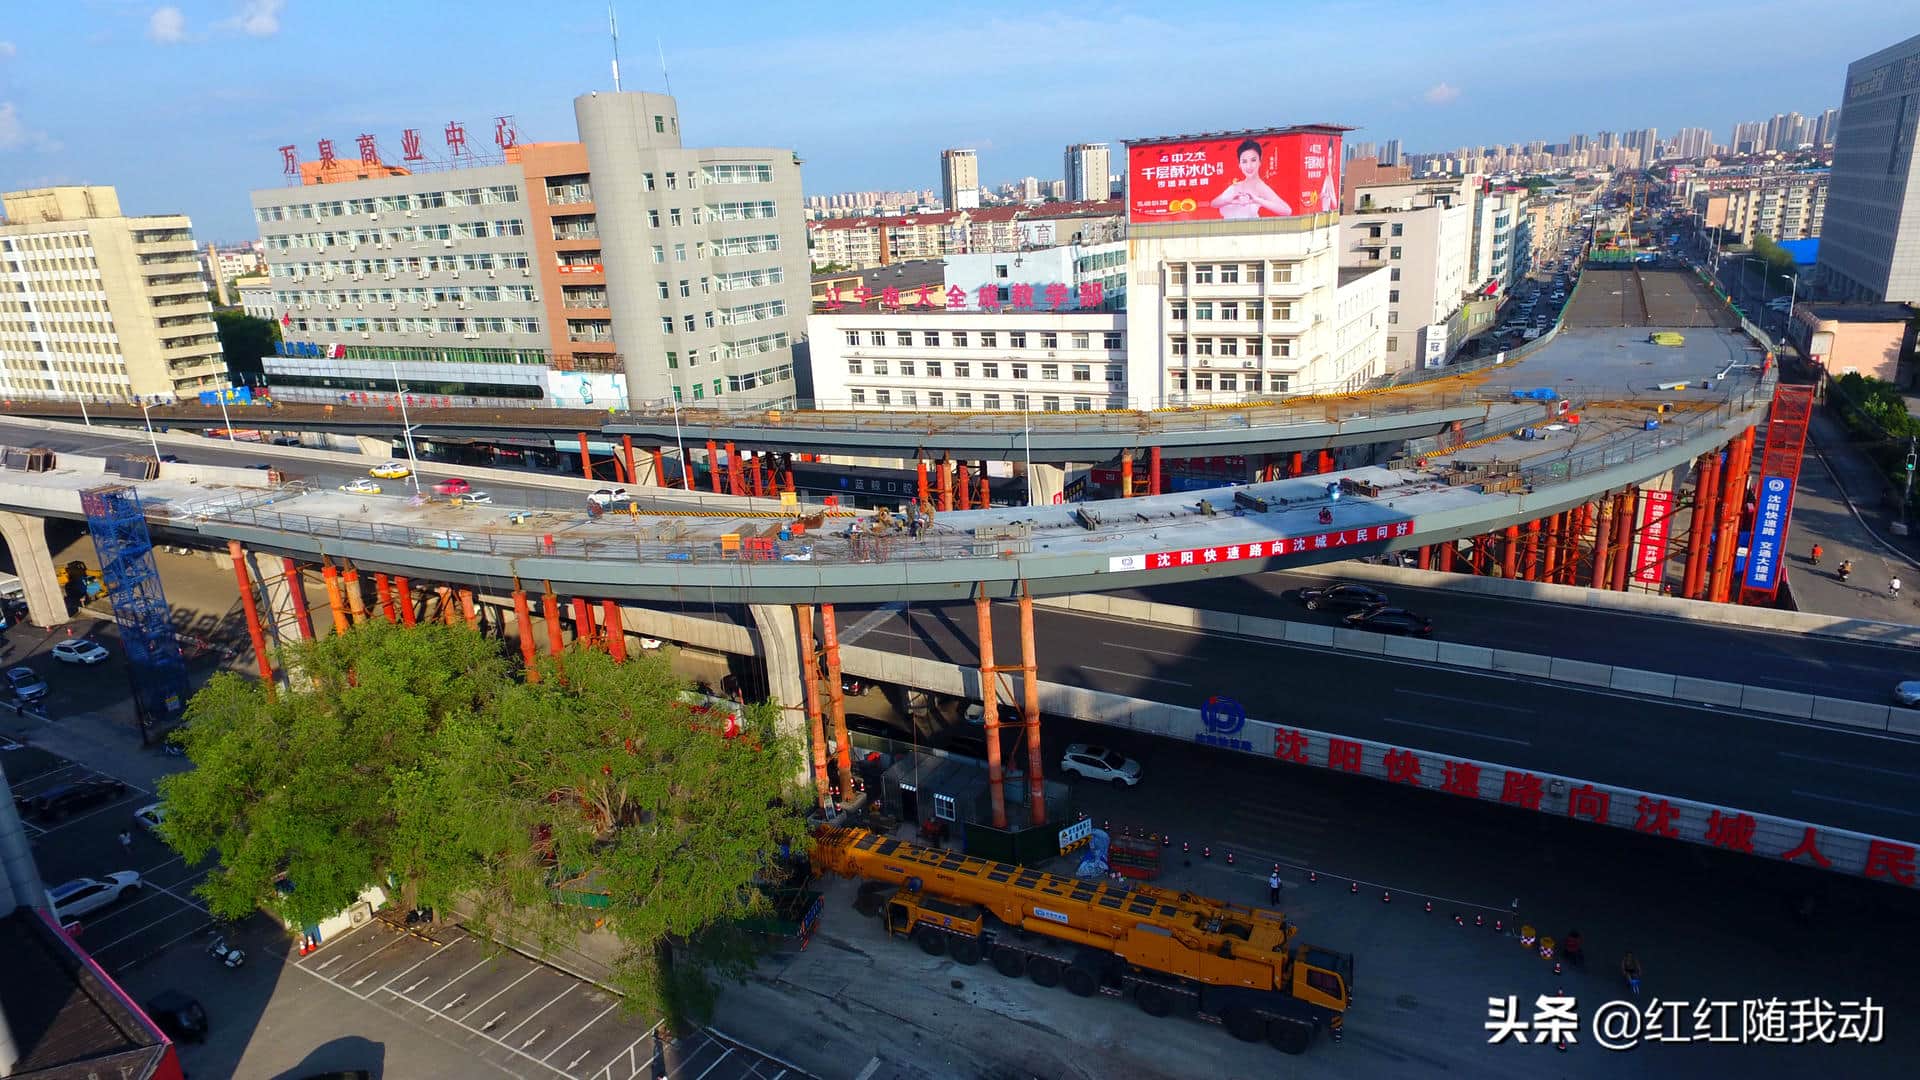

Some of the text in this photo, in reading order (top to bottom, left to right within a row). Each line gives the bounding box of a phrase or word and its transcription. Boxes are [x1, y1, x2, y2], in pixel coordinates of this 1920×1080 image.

[279, 116, 516, 174] 万泉商业中心
[1157, 521, 1409, 567] 沈阳快速路向沈城人民问好
[1274, 728, 1917, 886] 沈阳快速路向沈城人民
